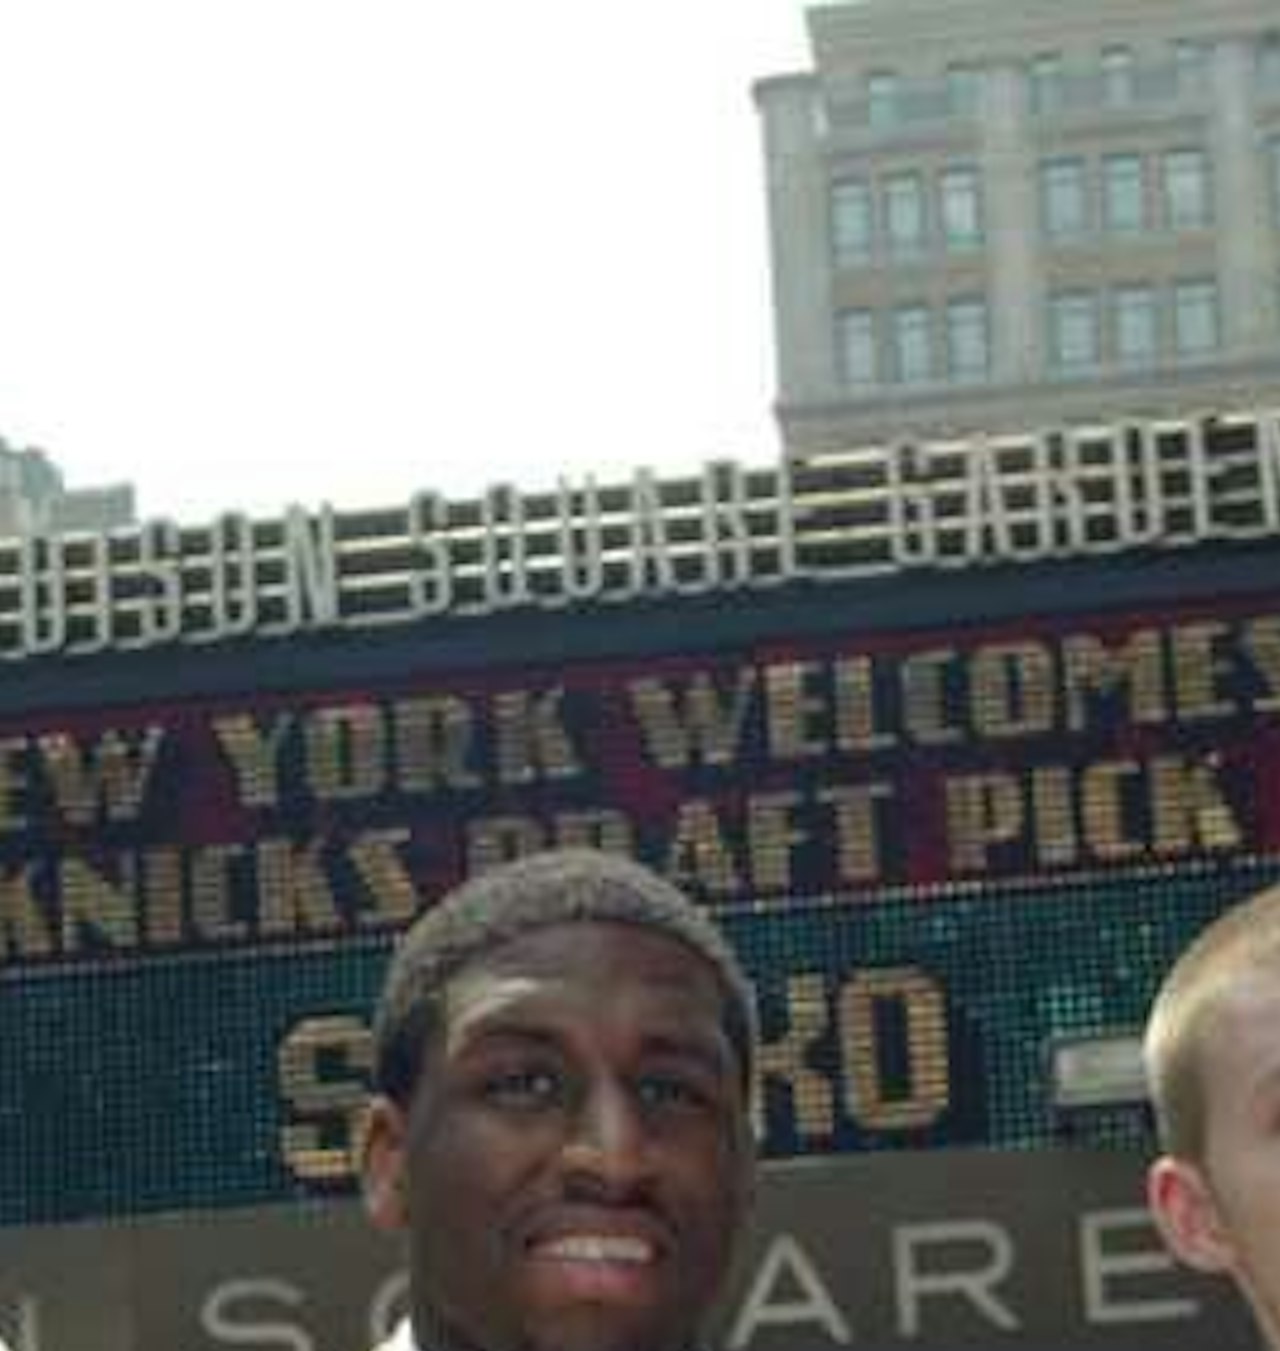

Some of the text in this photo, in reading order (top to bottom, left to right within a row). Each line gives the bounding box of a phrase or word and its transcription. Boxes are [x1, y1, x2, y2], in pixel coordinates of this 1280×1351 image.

[409, 456, 798, 616] SQUARE
[210, 684, 588, 810] YORK
[942, 751, 1245, 874] PICK
